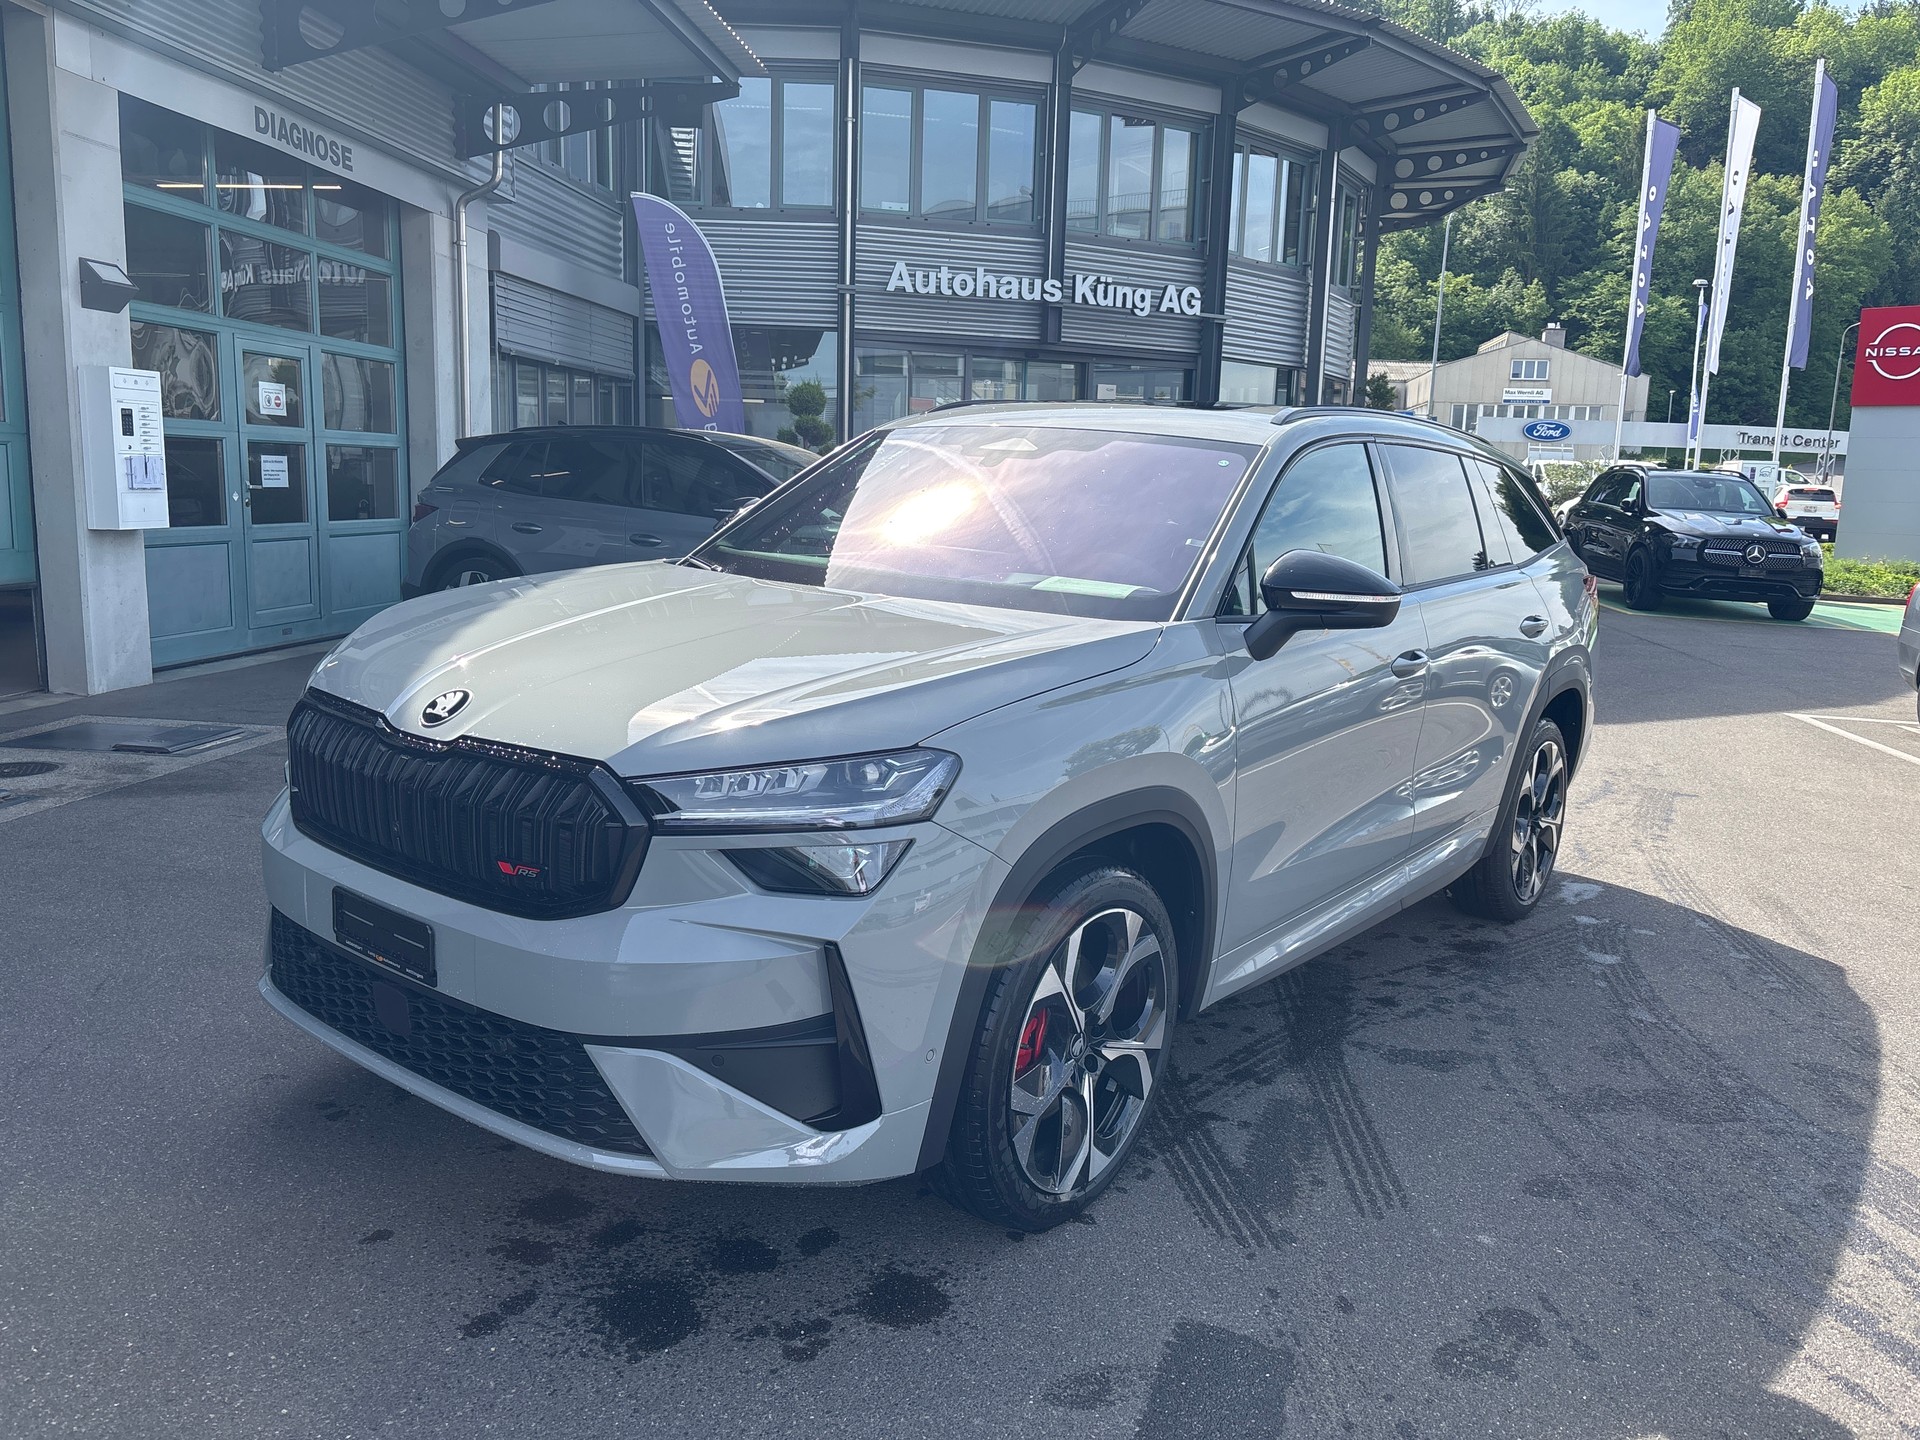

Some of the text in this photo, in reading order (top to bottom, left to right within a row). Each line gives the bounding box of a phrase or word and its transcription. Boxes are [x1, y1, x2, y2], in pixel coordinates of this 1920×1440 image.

[254, 105, 353, 172] DIAGNOSE
[886, 262, 1201, 316] Autohaus Küng AG
[1793, 434, 1840, 448] Center
